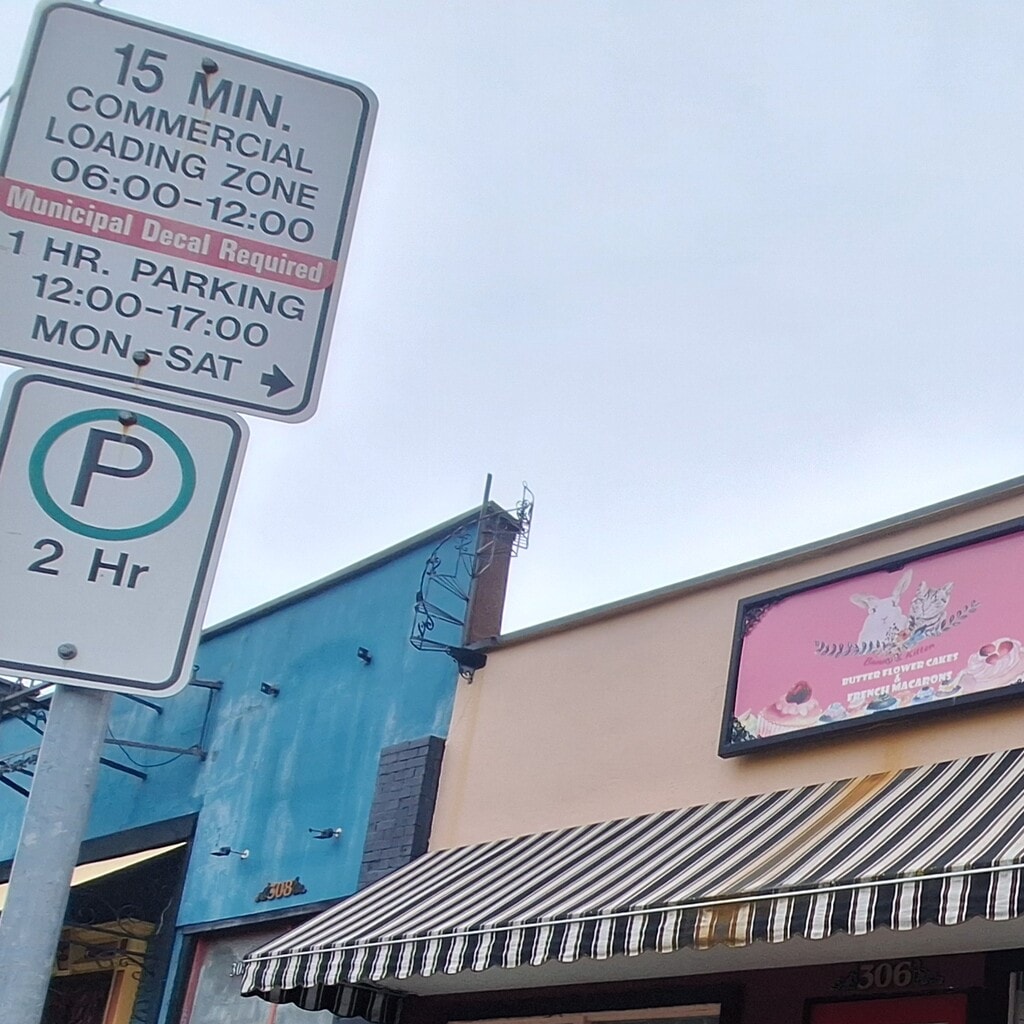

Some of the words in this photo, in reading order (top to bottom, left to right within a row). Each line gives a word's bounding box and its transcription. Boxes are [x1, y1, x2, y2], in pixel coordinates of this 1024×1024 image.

[114, 43, 168, 93] 15
[187, 71, 292, 132] MIN.
[45, 116, 207, 181] LOADING
[221, 163, 319, 210] ZONE
[66, 86, 314, 174] COMMERCIAL
[7, 185, 131, 236] Municipal
[142, 218, 209, 256] Decal
[219, 238, 323, 283] Required
[50, 156, 314, 243] 06:00-12:00
[8, 230, 24, 254] 1
[42, 237, 110, 276] HR.
[131, 258, 306, 322] PARKING
[32, 273, 269, 347] 12:00-17:00
[70, 428, 154, 507] P
[27, 538, 64, 576] 2
[87, 548, 150, 589] Hr
[842, 671, 880, 686] BUTTER
[882, 660, 924, 677] FLOWER
[926, 652, 959, 667] CAKES
[847, 685, 890, 702] FRENCH
[891, 671, 953, 692] MACARONS
[894, 674, 901, 683] &
[267, 880, 293, 900] 308
[229, 962, 245, 977] 30
[857, 961, 912, 988] 306
